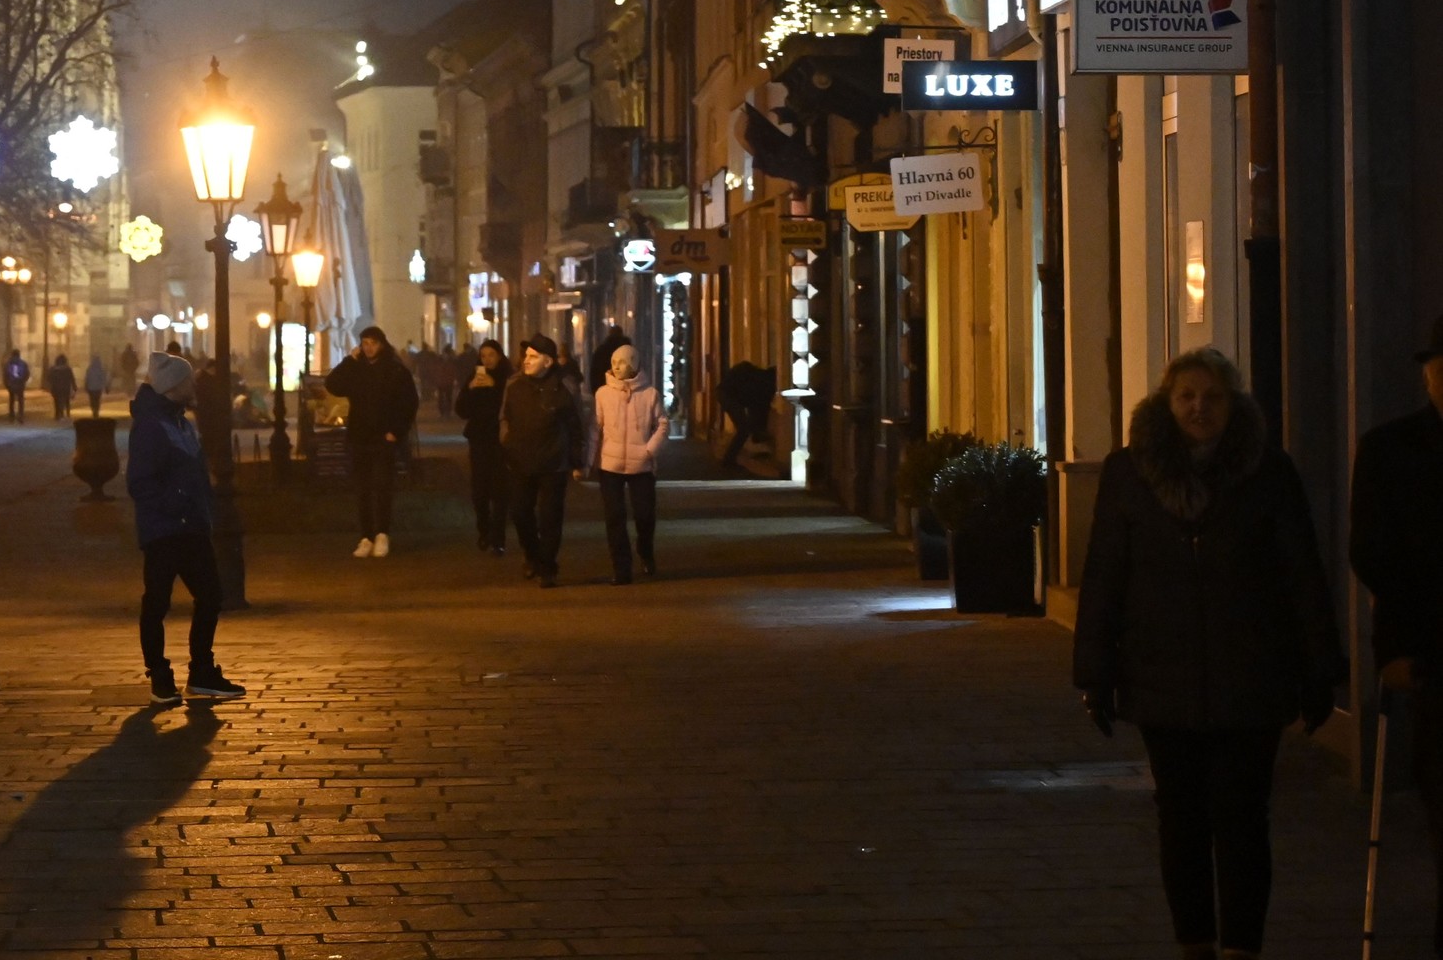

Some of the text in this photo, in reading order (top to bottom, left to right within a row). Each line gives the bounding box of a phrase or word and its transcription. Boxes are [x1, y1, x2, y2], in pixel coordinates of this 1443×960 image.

[1110, 15, 1208, 32] POISŤOVŇA
[896, 46, 943, 61] Priestory
[1096, 44, 1233, 53] VIENNA INSURANCE GROUP
[887, 72, 900, 83] na
[924, 74, 1015, 96] LUXE
[898, 166, 975, 185] Hlavná 60
[904, 188, 972, 206] pri Divadle
